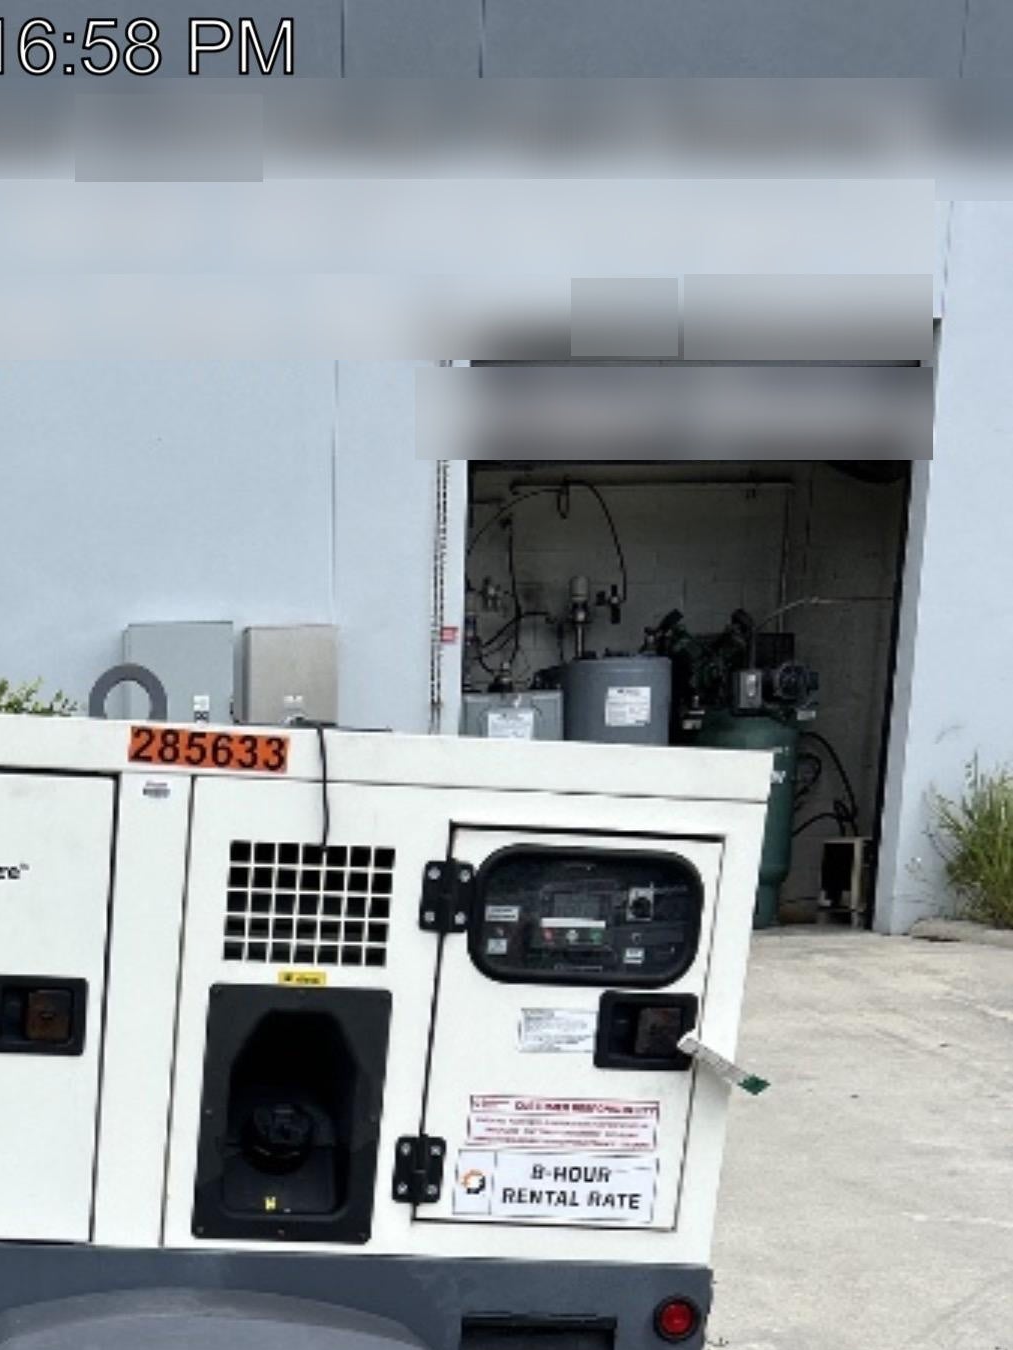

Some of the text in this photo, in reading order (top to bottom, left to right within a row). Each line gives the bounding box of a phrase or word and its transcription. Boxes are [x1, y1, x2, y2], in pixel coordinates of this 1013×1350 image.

[130, 727, 286, 771] 285633
[530, 1163, 612, 1183] 8-HOUR
[501, 1187, 642, 1210] RENTAL RATE
